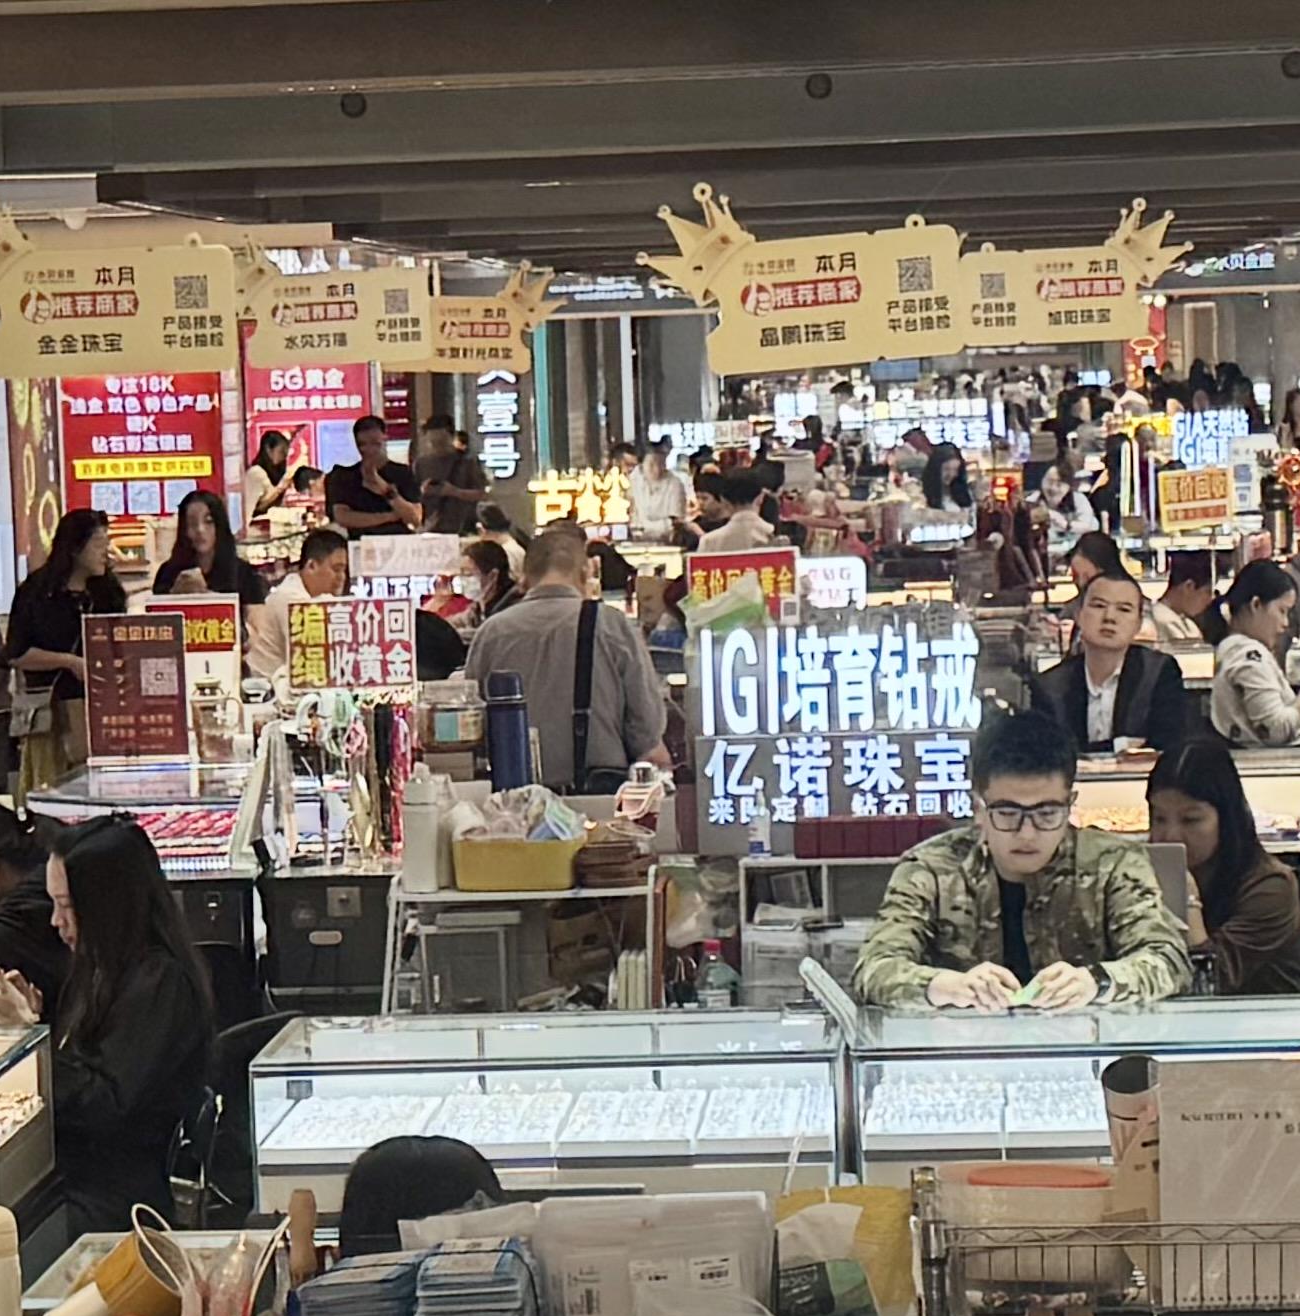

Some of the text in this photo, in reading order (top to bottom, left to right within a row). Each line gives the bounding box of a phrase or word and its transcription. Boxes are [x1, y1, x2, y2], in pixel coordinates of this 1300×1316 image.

[816, 252, 857, 274] 本月
[1088, 259, 1119, 274] 本月
[95, 266, 136, 287] 本月
[326, 283, 356, 298] 本月
[775, 279, 860, 308] 推荐商家
[53, 294, 136, 318] 推荐商家
[163, 315, 224, 331] 产品接受
[327, 602, 413, 644] 高价回
[329, 646, 413, 685] 收黄金
[701, 622, 982, 737] IGI培育钻戒
[705, 733, 973, 797] 亿诺珠宝
[851, 793, 974, 819] 钻石回收
